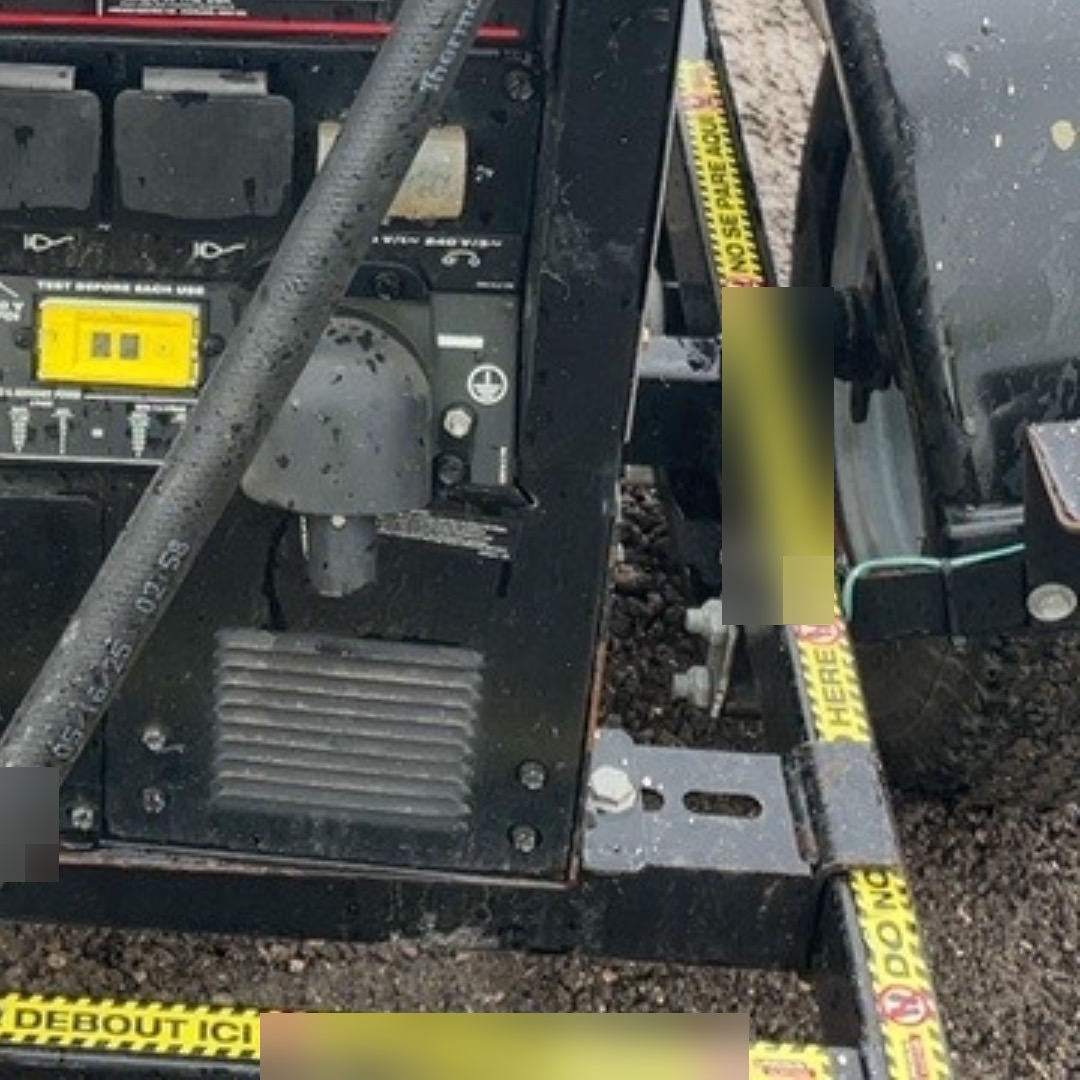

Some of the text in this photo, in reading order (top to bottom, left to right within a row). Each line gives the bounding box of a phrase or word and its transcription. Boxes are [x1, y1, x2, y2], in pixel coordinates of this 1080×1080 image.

[37, 280, 205, 295] TEST BEFORE EACH USE
[813, 647, 851, 726] HERE
[877, 919, 910, 977] DO
[13, 1007, 188, 1039] DEBOUT
[196, 1020, 252, 1044] ICI
